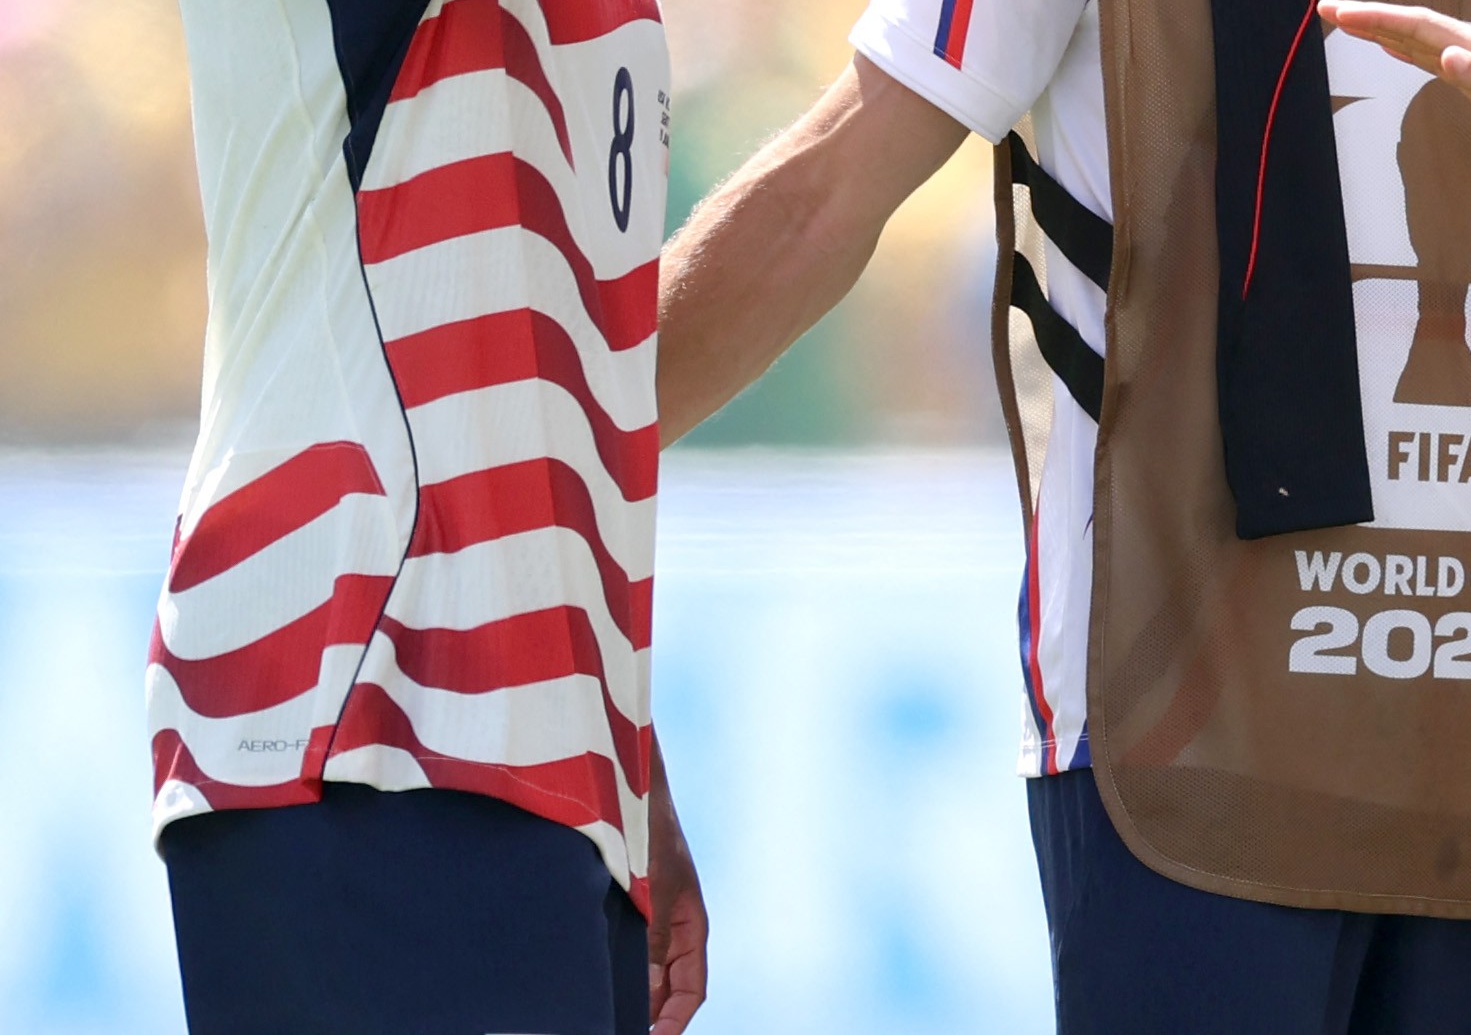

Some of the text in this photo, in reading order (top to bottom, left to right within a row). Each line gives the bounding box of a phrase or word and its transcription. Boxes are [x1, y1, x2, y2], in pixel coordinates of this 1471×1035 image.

[608, 66, 635, 233] 8
[1295, 550, 1465, 597] WORLD
[238, 738, 311, 753] AERO-F
